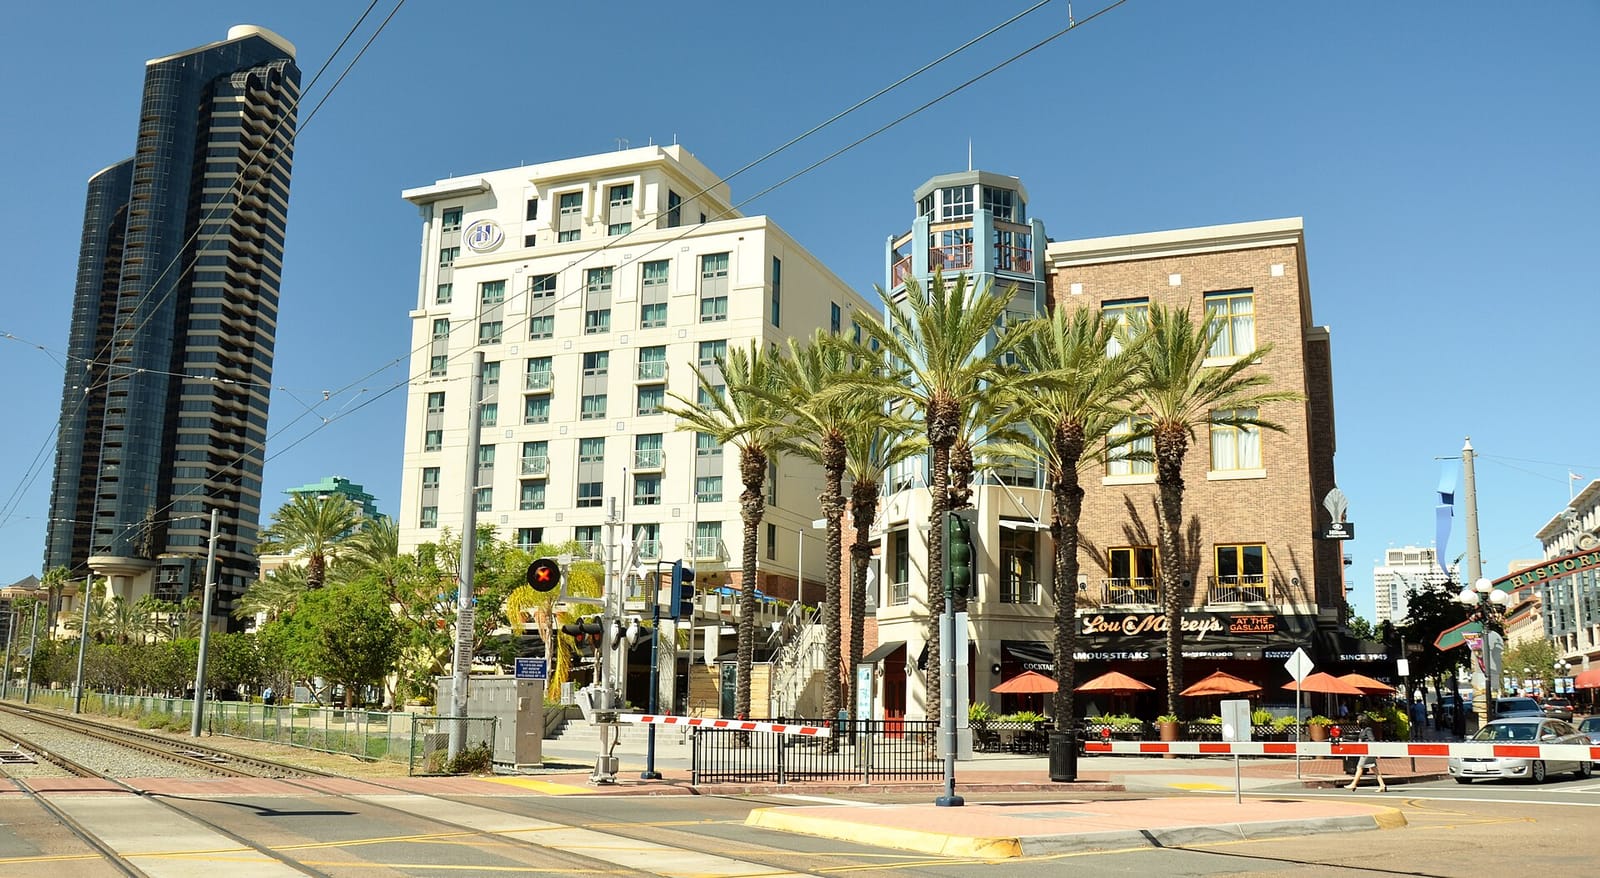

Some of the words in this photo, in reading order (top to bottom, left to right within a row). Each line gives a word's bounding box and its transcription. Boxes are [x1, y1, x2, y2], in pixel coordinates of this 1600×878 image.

[1082, 615, 1121, 635] Lou
[1137, 614, 1223, 641] Mikey's
[1229, 623, 1275, 631] GASLAMP
[1110, 651, 1149, 659] STEAKS
